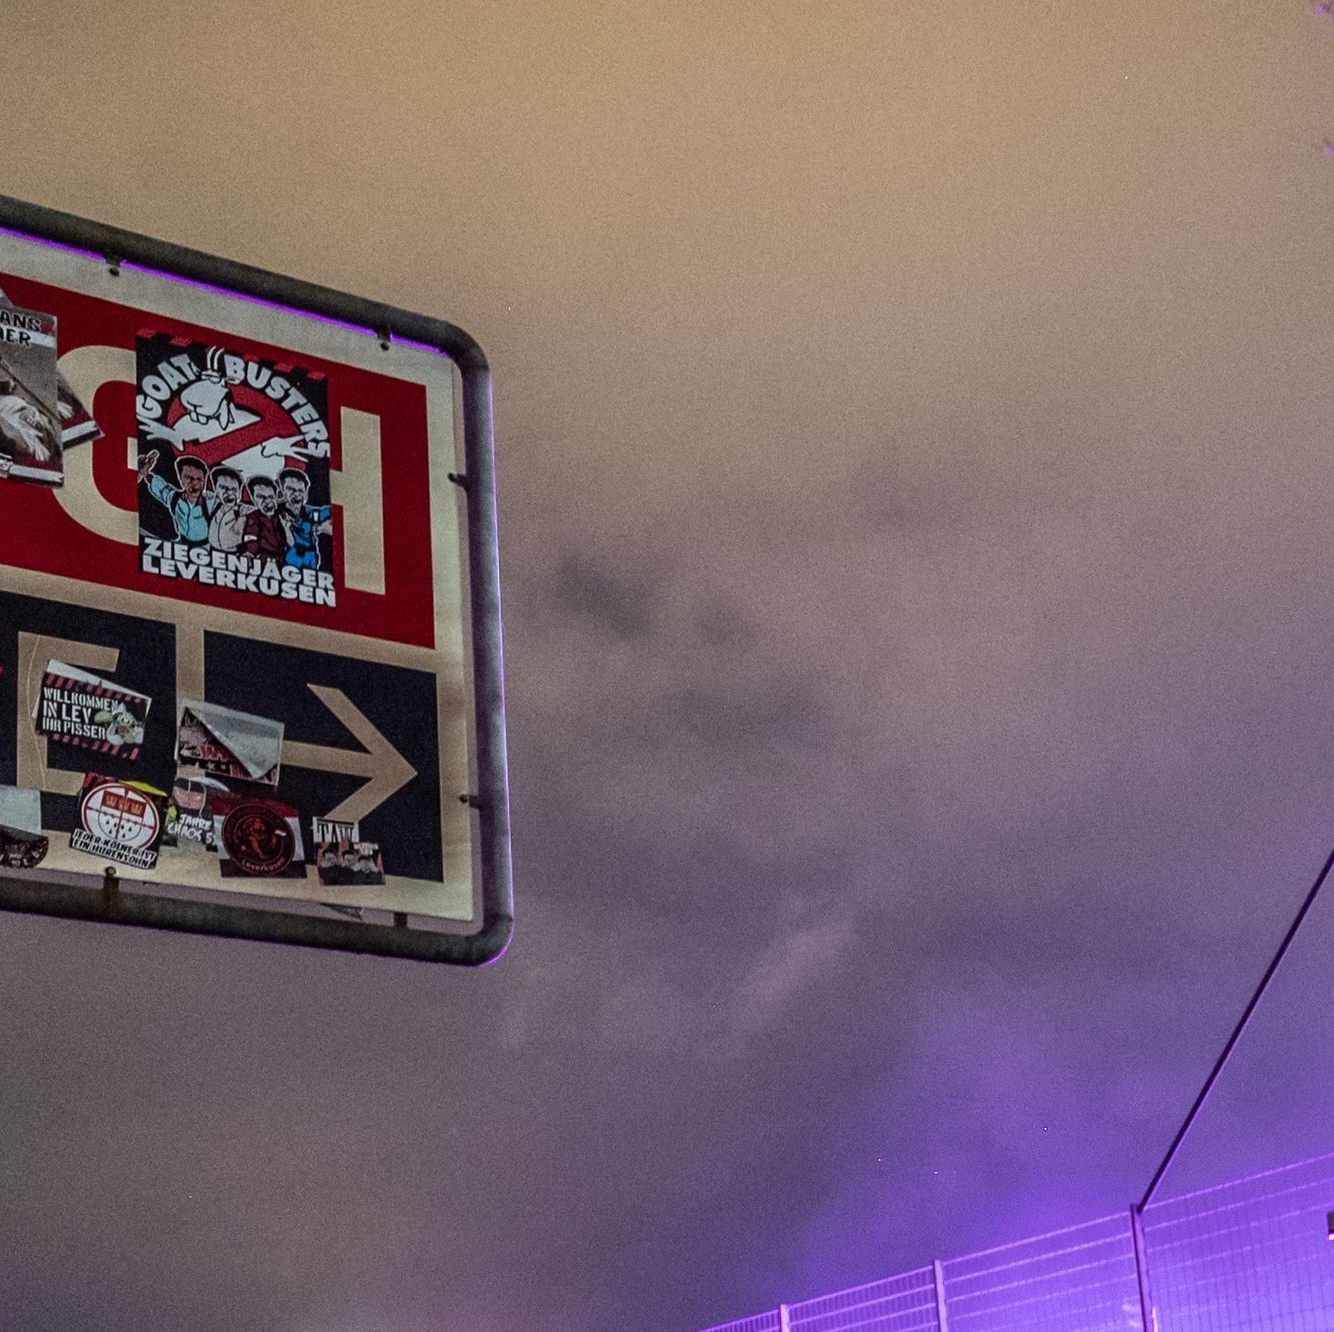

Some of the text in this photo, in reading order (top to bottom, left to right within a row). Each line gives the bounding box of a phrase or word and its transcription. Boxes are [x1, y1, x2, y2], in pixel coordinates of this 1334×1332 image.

[136, 353, 330, 459] GOAT BUSTERS
[142, 555, 336, 607] LEVERKUSEN
[144, 538, 335, 589] ZIEGENJÄGER
[43, 687, 118, 711] WILLKOMMEN
[43, 699, 92, 724] IN LEV
[64, 721, 106, 740] PISSER
